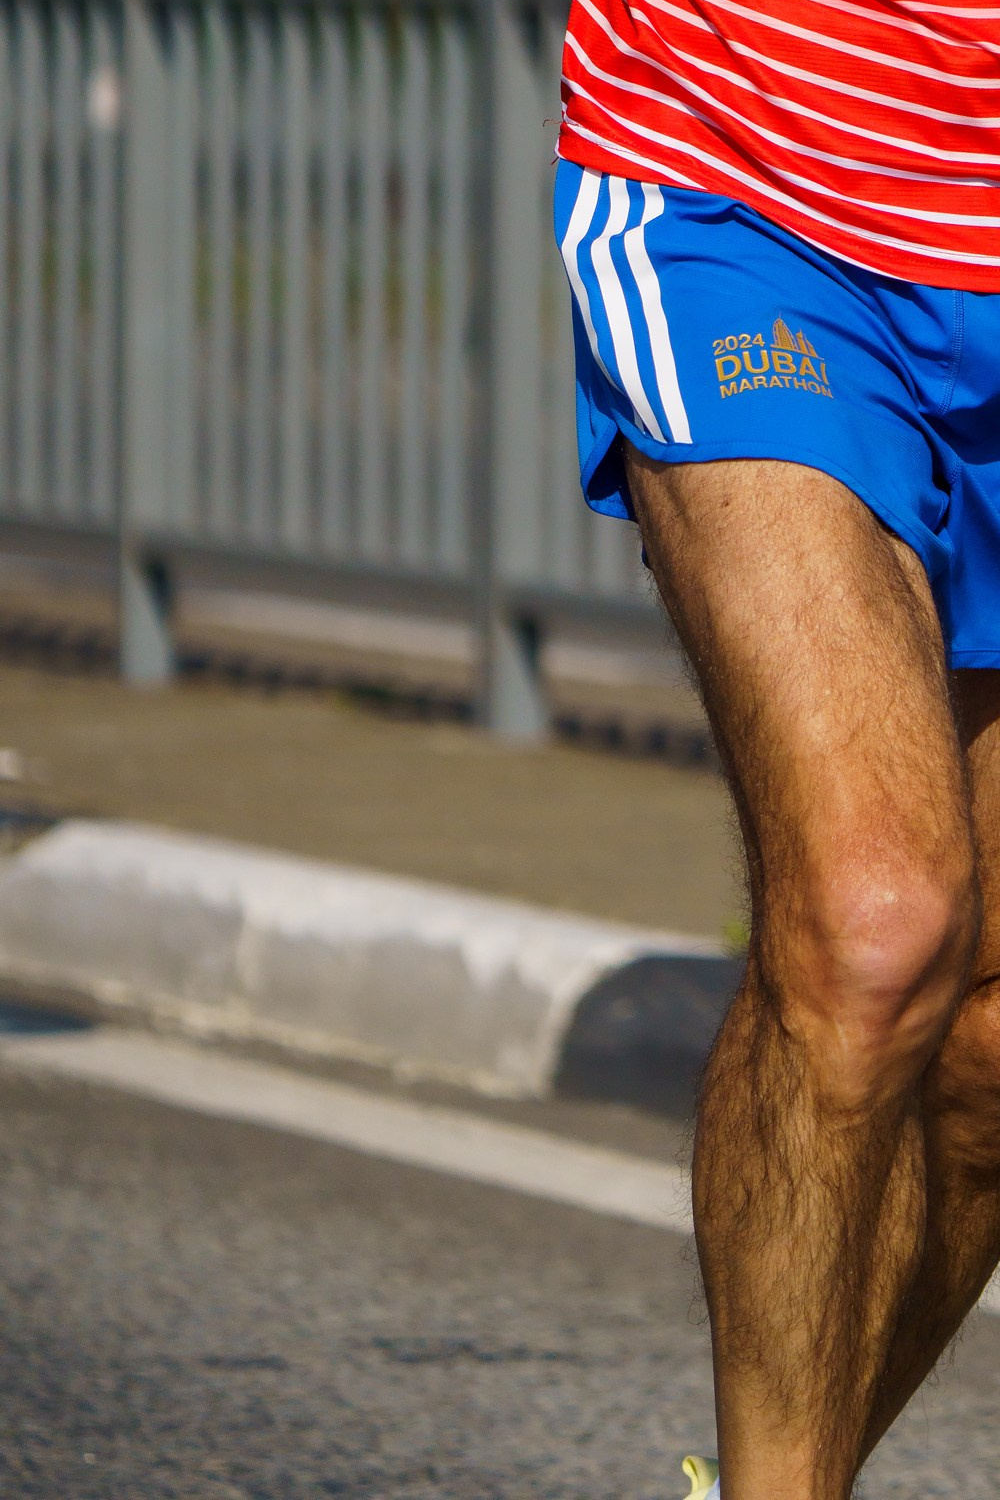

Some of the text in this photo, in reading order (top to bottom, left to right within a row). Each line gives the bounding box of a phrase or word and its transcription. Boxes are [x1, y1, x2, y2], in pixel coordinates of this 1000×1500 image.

[712, 333, 766, 356] 2024
[714, 350, 829, 386] DUBAI
[719, 375, 834, 399] MARATHON
